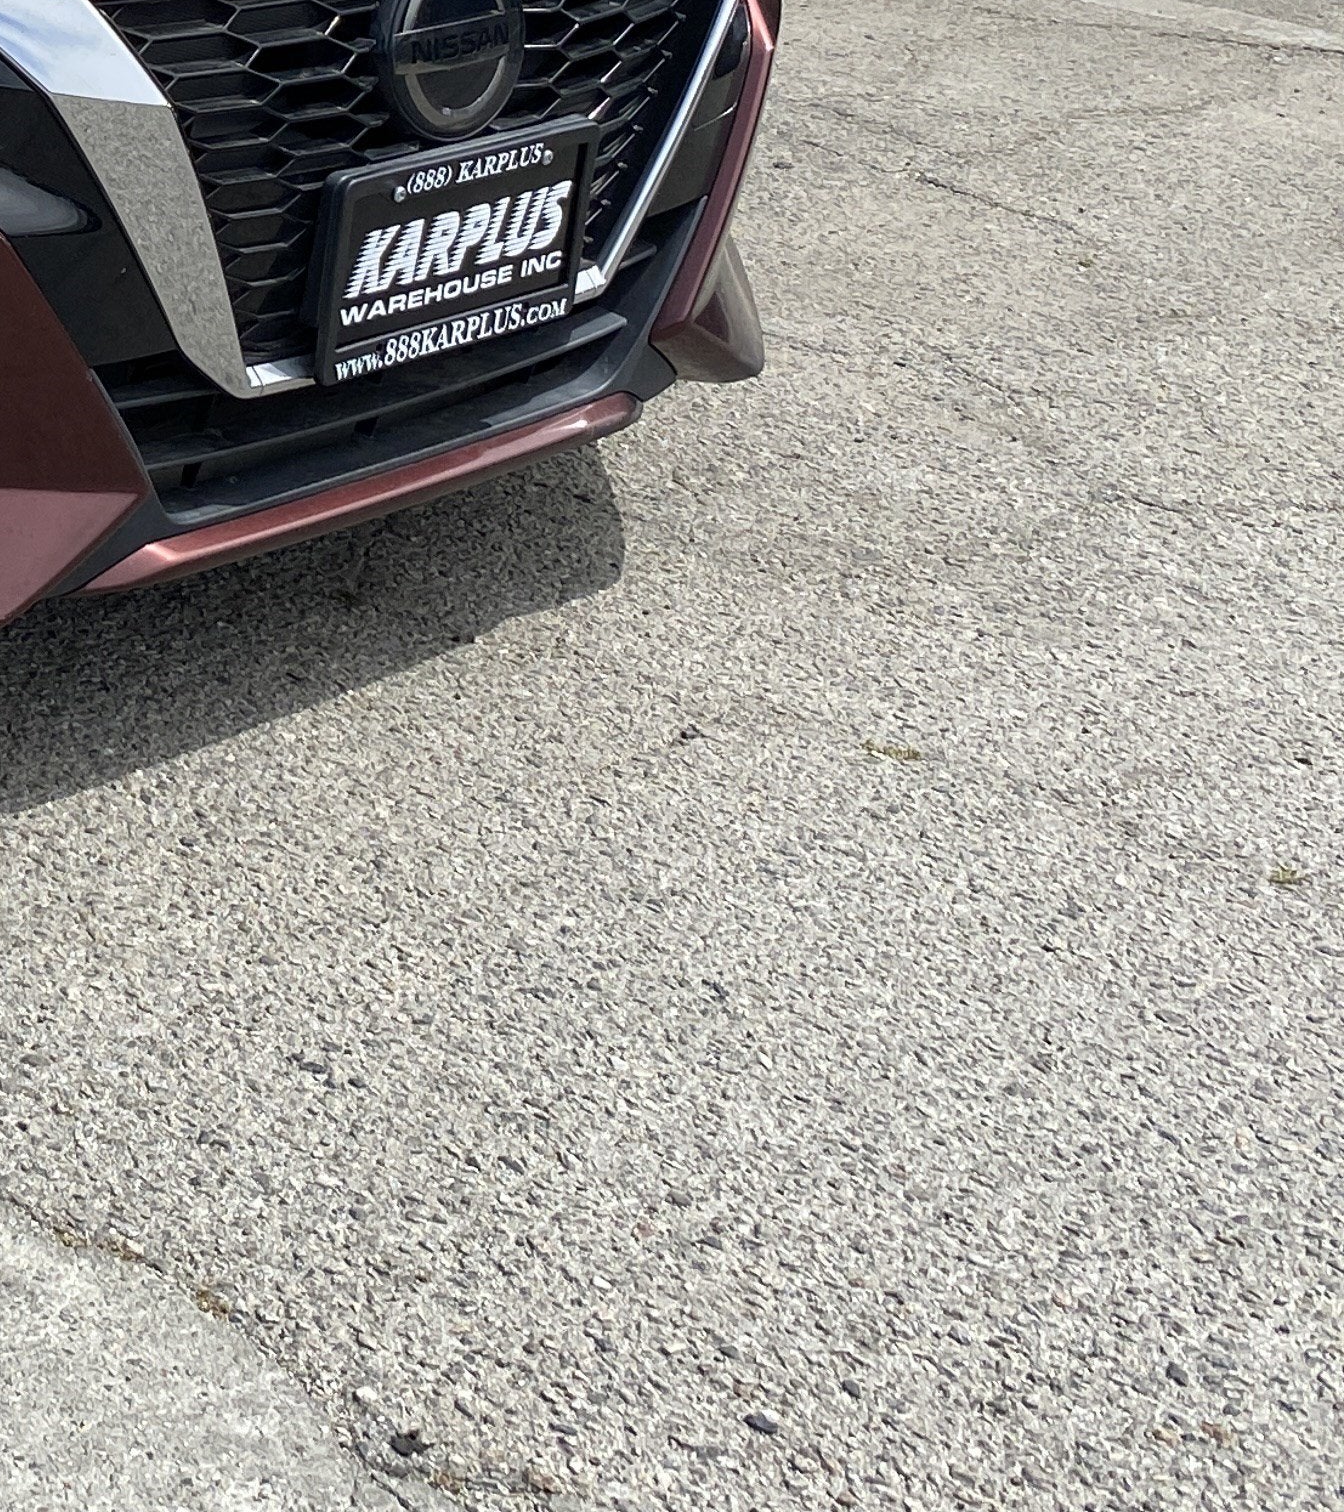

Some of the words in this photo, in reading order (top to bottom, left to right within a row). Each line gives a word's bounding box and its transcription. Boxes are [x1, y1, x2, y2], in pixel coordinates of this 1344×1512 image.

[407, 166, 453, 194] (888)
[455, 142, 544, 184] KARPLUS
[342, 180, 573, 300] KARPLUS
[340, 264, 513, 327] WAREHOUSE
[520, 250, 562, 278] INC
